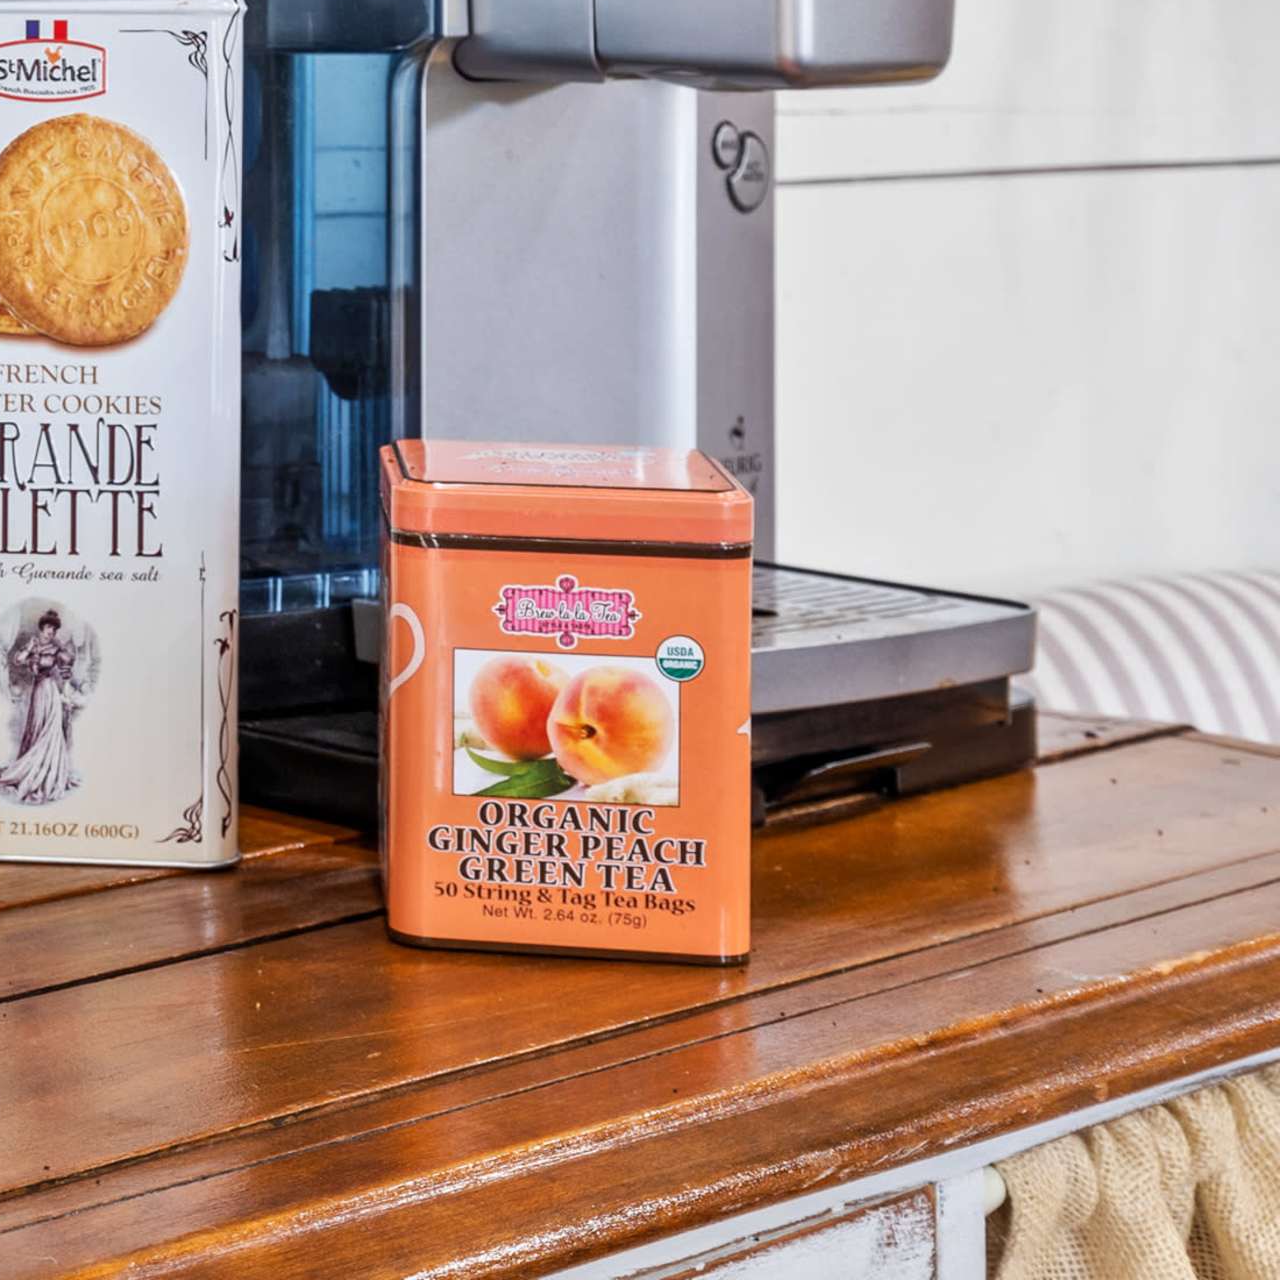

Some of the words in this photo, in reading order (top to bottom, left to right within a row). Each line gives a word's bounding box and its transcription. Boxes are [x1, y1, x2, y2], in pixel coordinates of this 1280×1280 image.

[43, 394, 162, 416] COOKIES
[99, 571, 123, 582] sea
[130, 565, 161, 582] salt
[667, 646, 694, 657] USDA
[9, 821, 80, 838] 21.16OZ
[84, 823, 140, 839] (600G)
[479, 801, 655, 835] ORGANIC
[428, 826, 568, 858] GINGER
[580, 834, 705, 867] PEACH
[458, 855, 584, 888] GREEN
[596, 863, 675, 892] TEA
[434, 882, 458, 897] 50
[464, 883, 532, 904] String
[536, 888, 553, 904] &
[559, 888, 597, 909] Tag
[601, 891, 639, 909] Tea
[644, 894, 696, 915] Bags
[482, 904, 508, 918] Net
[543, 908, 575, 922] 2.64
[608, 912, 648, 929] (75g)
